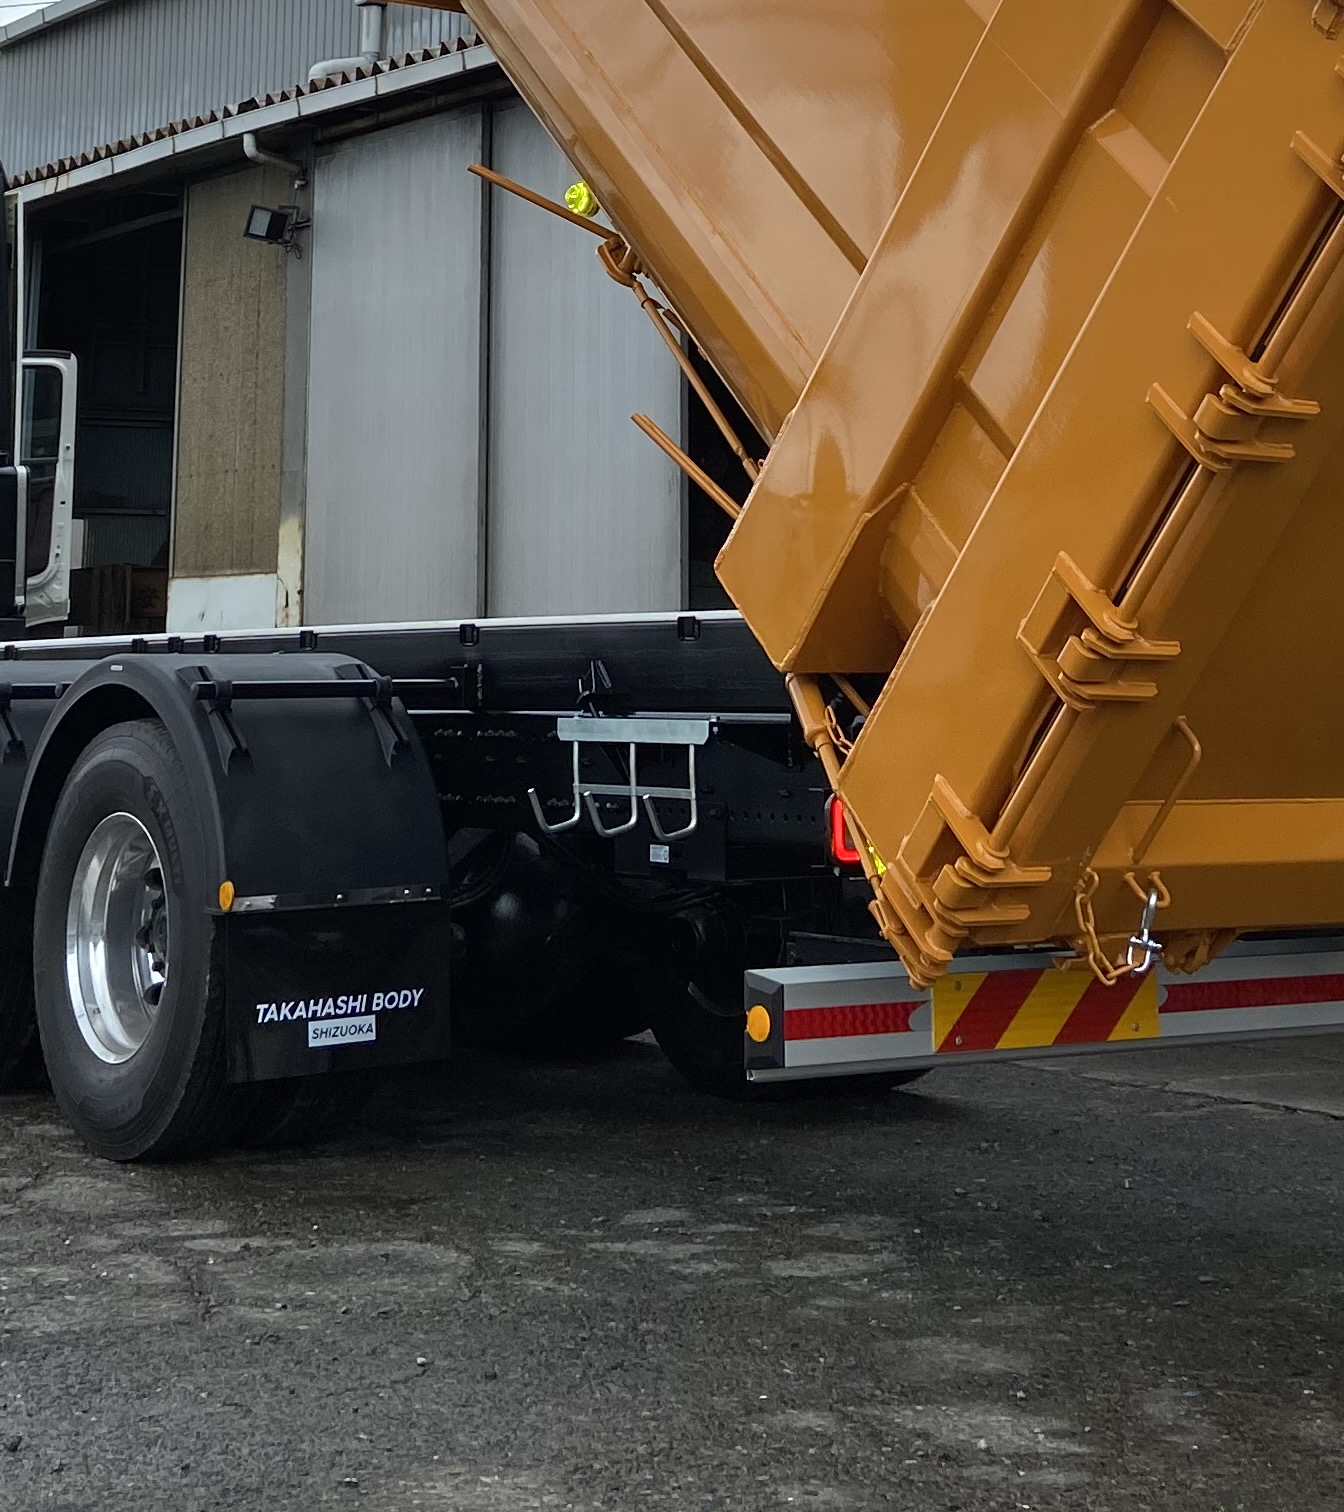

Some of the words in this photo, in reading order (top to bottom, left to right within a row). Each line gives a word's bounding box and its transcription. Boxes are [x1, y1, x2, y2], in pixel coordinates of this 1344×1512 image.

[256, 994, 366, 1023] TAKAHASHI
[372, 988, 424, 1011] BODY
[311, 1022, 374, 1039] SHIZUOKA
